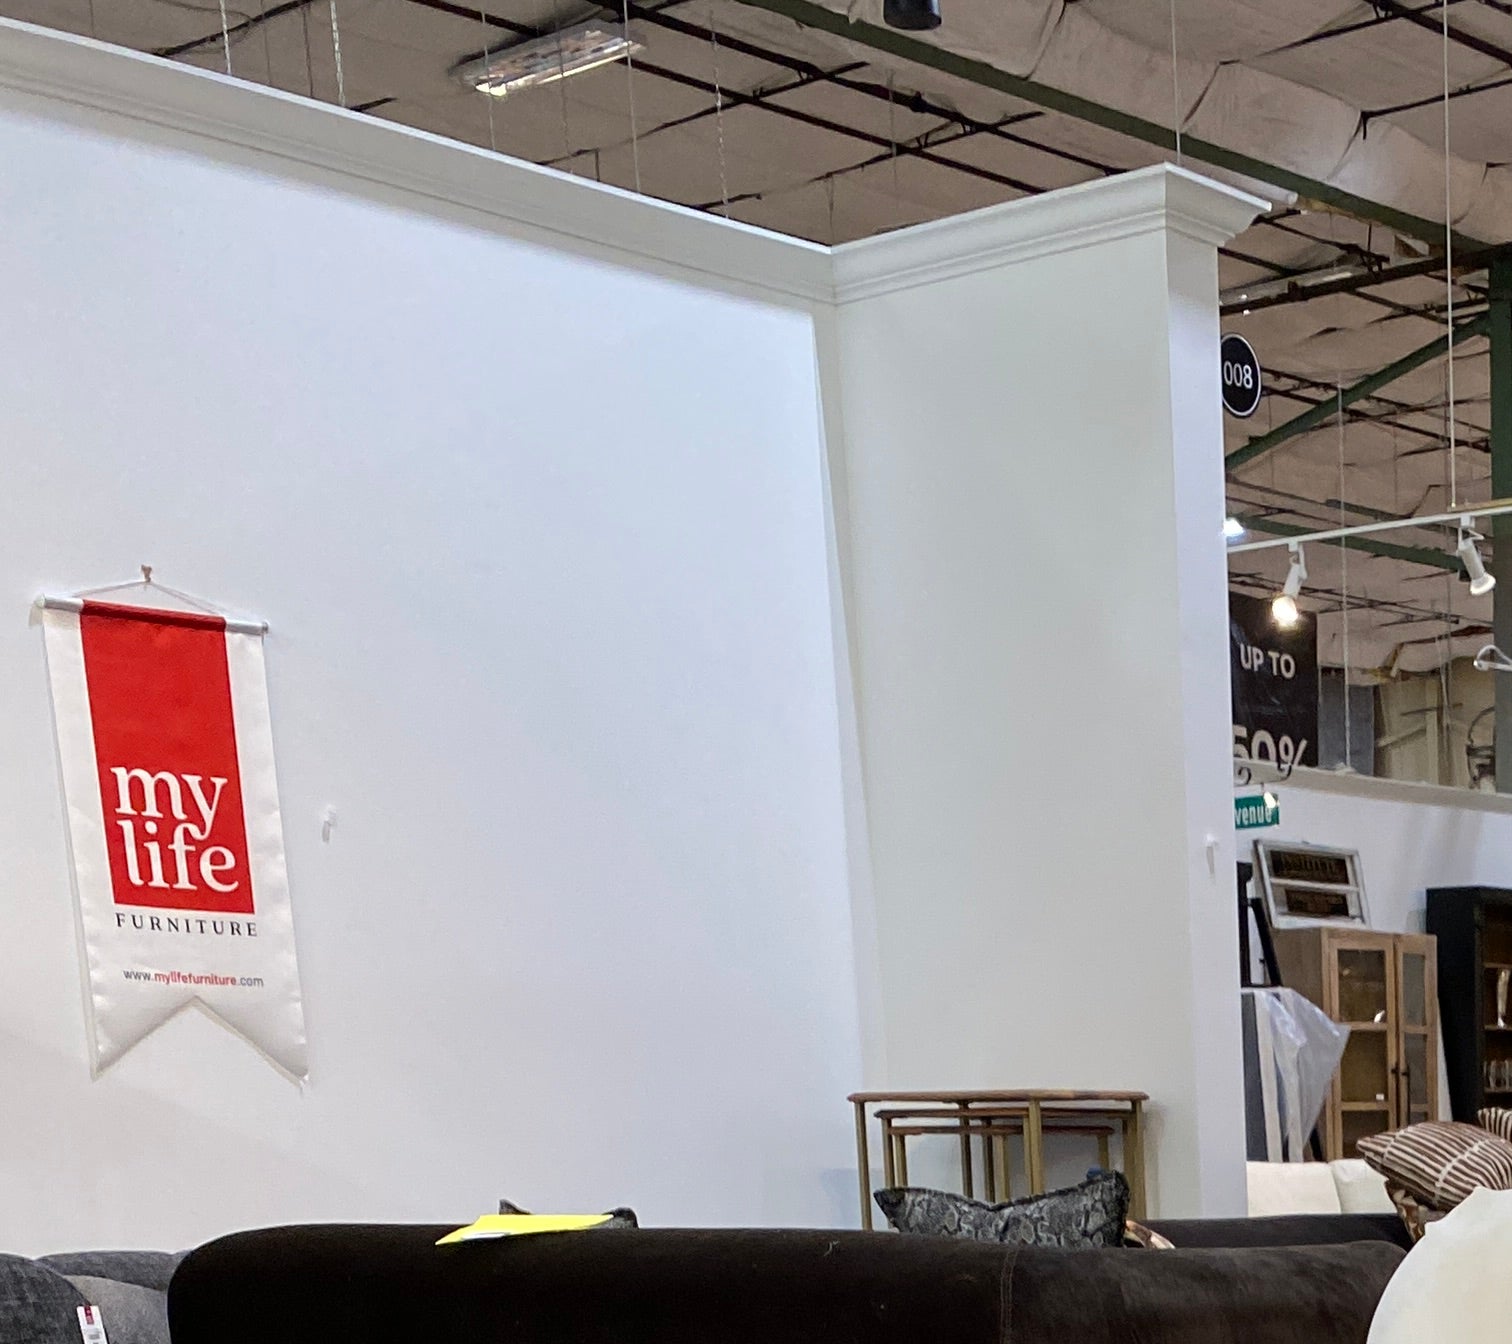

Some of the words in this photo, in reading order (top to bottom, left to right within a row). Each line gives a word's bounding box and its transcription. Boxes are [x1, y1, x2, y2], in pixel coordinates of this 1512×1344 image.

[1223, 361, 1253, 389] 008
[1240, 643, 1264, 672] UP
[1268, 651, 1296, 679] TO
[110, 766, 228, 841] my
[117, 820, 239, 893] life
[115, 912, 258, 937] FURNITURE
[123, 969, 264, 988] www.mylifefurniture.com
